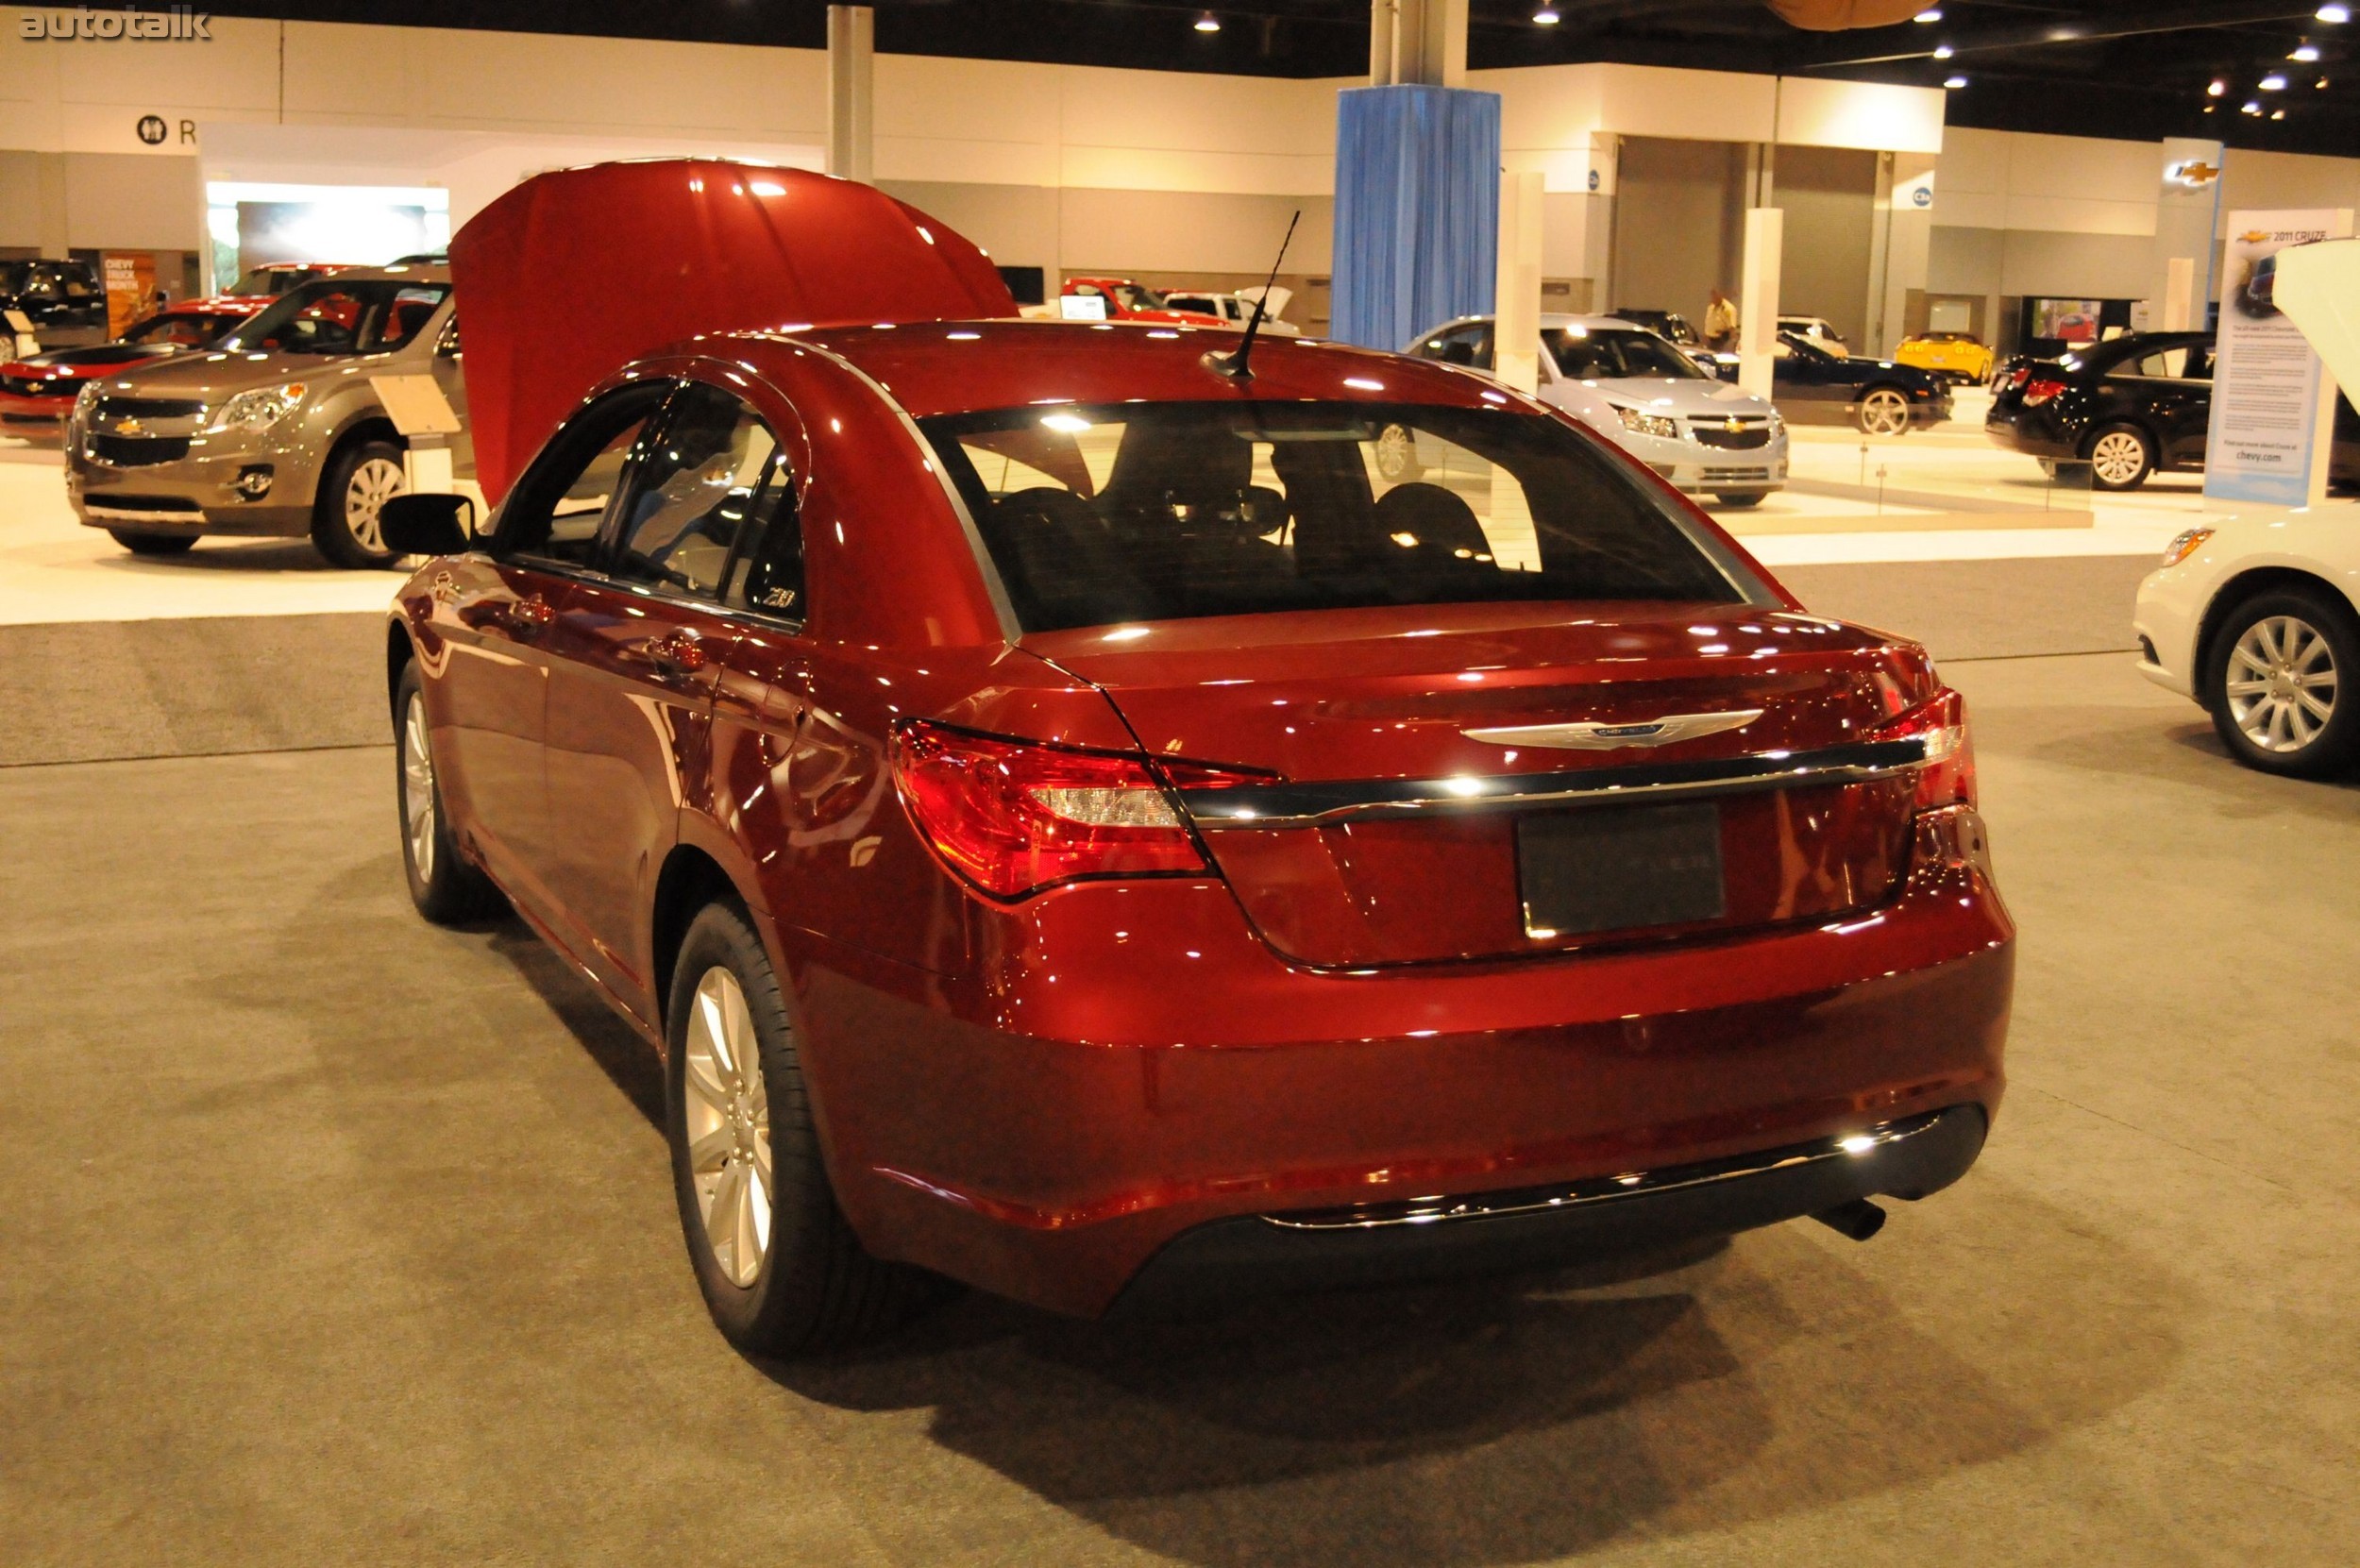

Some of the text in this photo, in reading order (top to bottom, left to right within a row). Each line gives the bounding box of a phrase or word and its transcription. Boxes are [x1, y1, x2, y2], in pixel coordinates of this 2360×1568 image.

[2273, 230, 2327, 242] 2011 CRUZE
[2235, 450, 2282, 463] chevy.com
